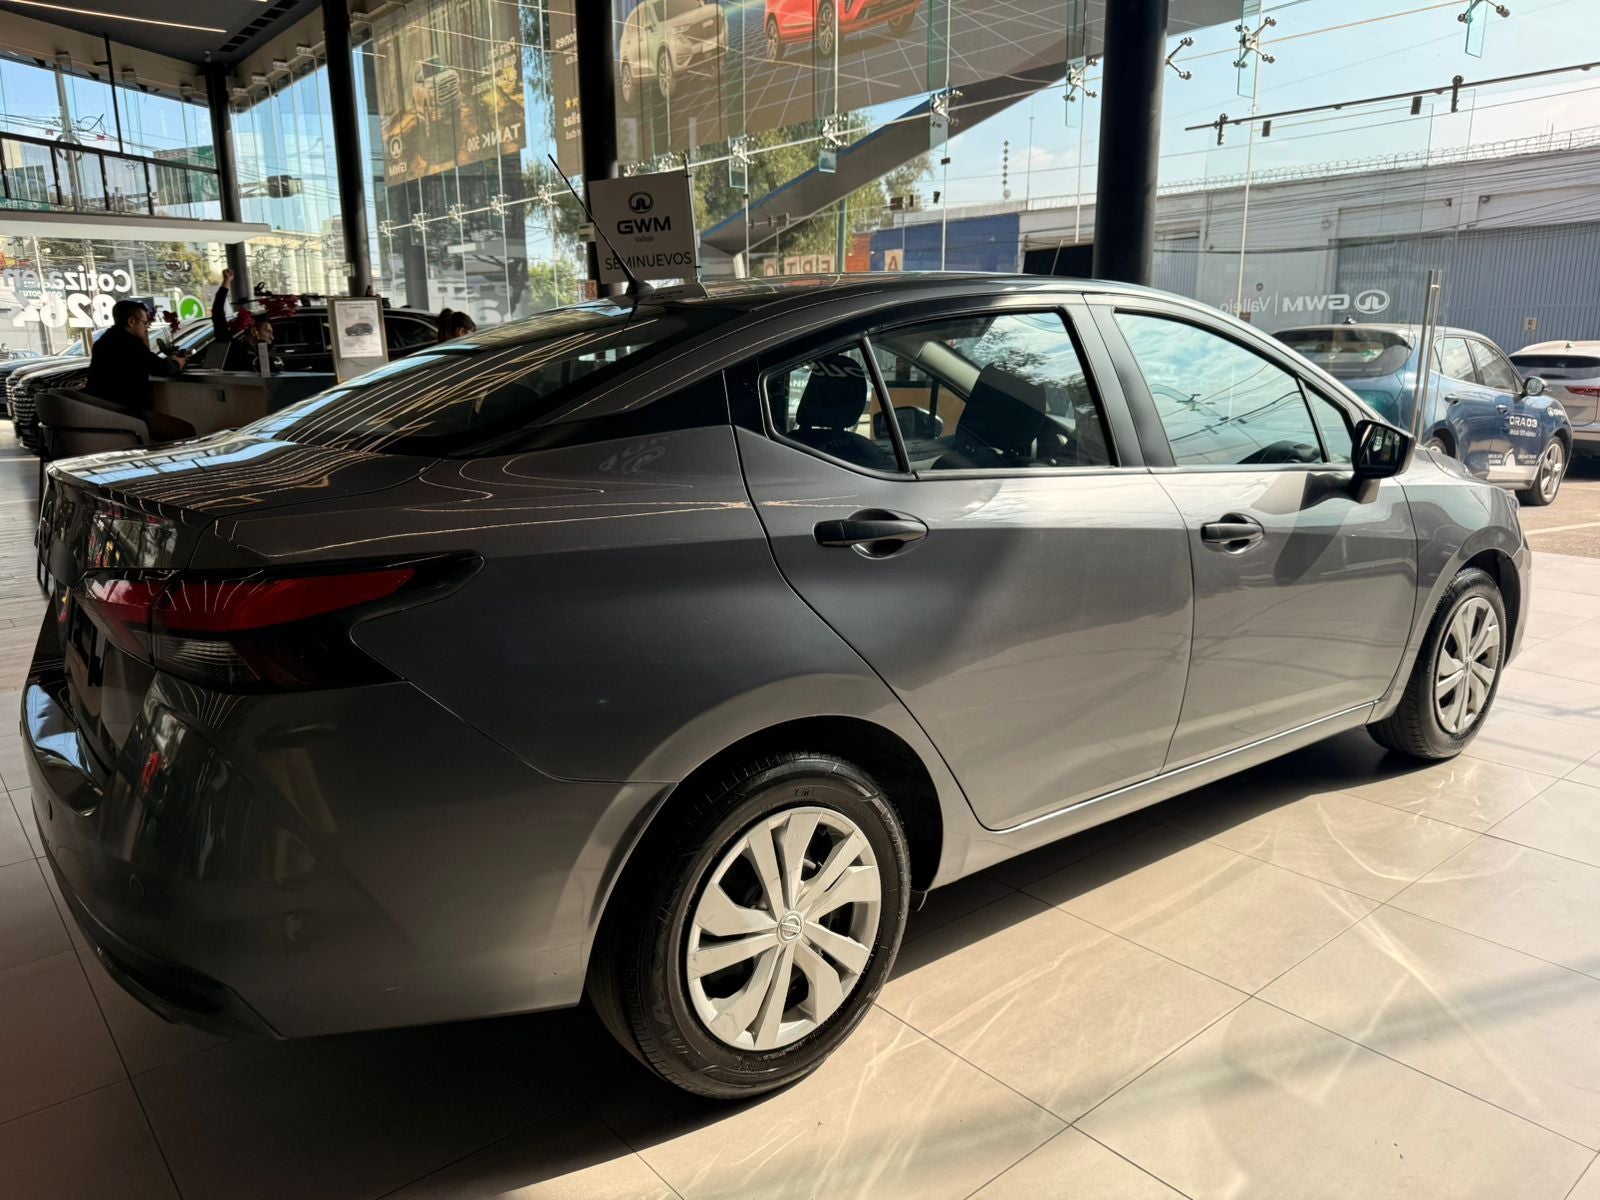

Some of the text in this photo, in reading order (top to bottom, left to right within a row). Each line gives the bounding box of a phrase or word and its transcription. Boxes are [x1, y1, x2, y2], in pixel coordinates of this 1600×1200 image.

[617, 216, 672, 235] GWM
[604, 251, 692, 270] SEMINUEVOS
[1509, 415, 1538, 428] ORA 03
